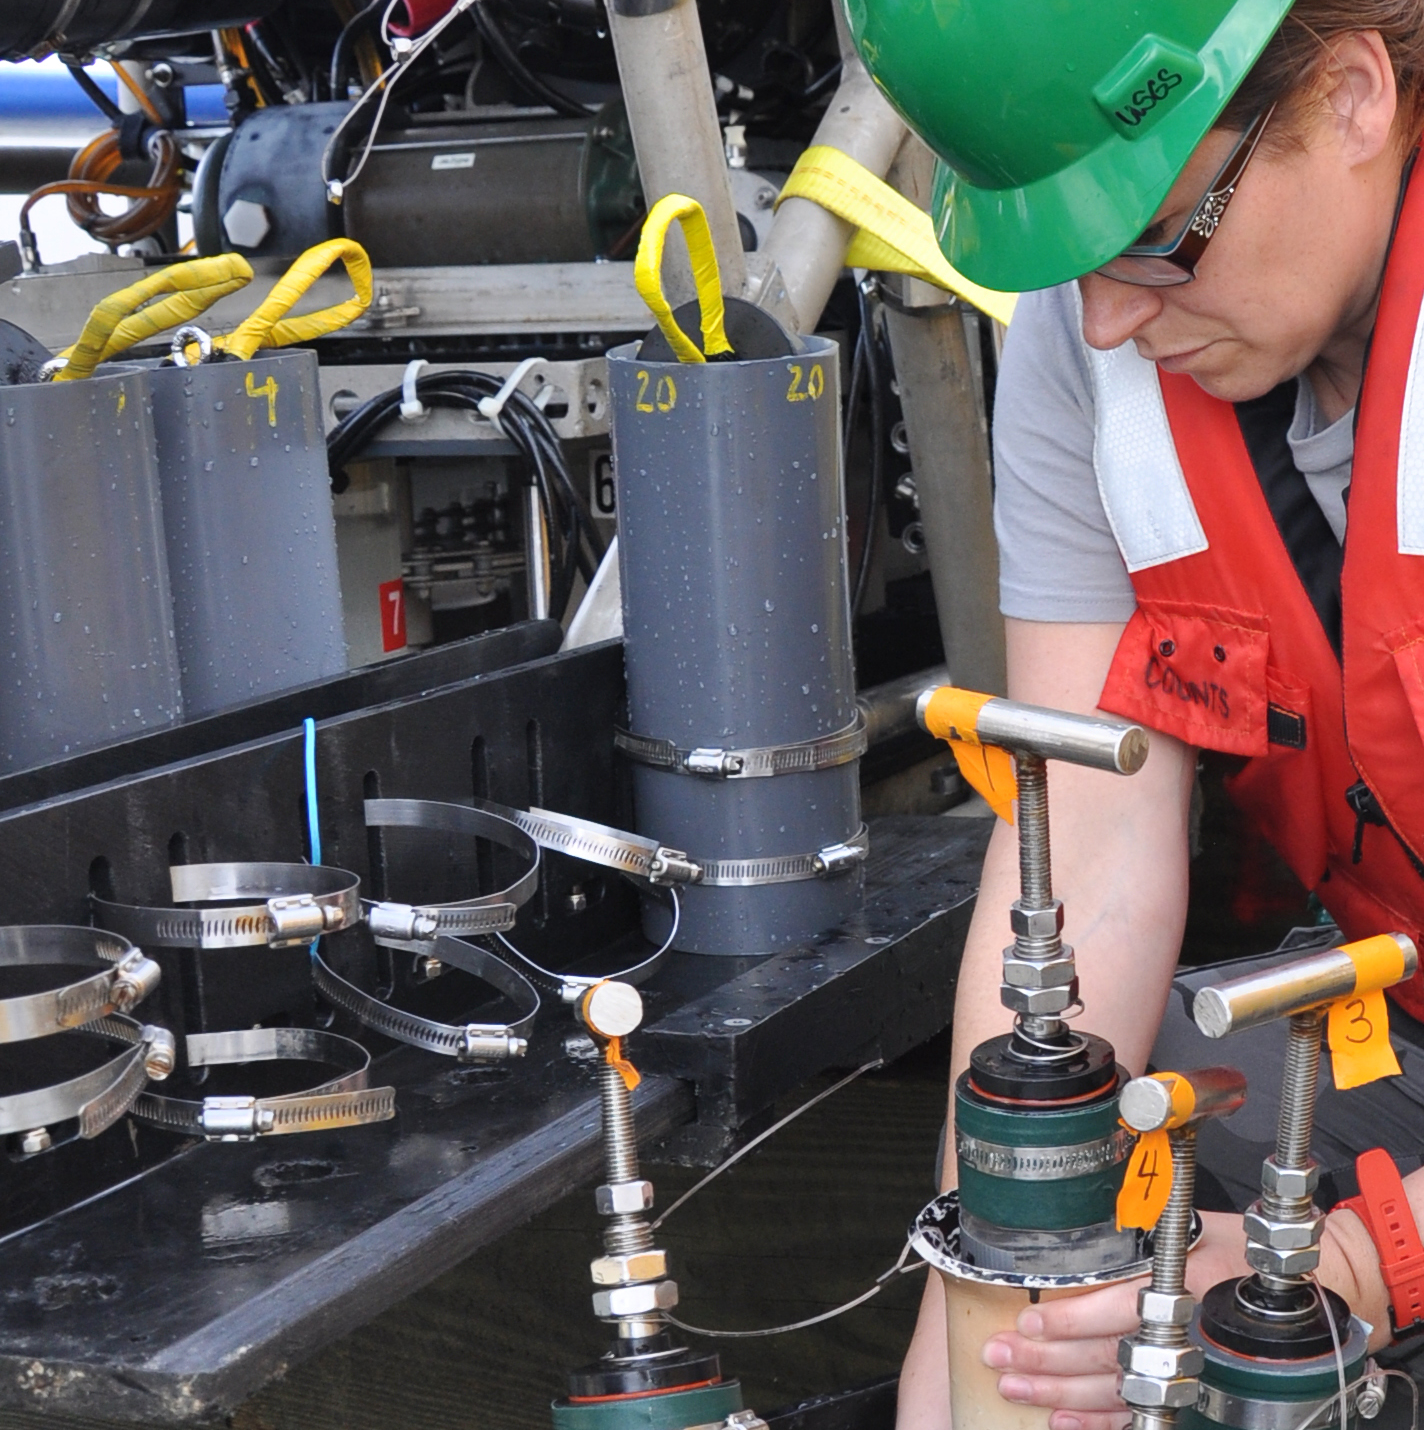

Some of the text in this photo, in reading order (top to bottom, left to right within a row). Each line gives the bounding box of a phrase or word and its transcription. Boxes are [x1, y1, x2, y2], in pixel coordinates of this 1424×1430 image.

[1115, 67, 1183, 127] USGS
[245, 372, 279, 428] 4
[636, 370, 678, 413] 20
[786, 364, 825, 403] 20
[388, 590, 401, 636] 7
[1144, 655, 1230, 720] COUNTS
[1345, 998, 1373, 1044] 3
[1137, 1149, 1160, 1201] 4
